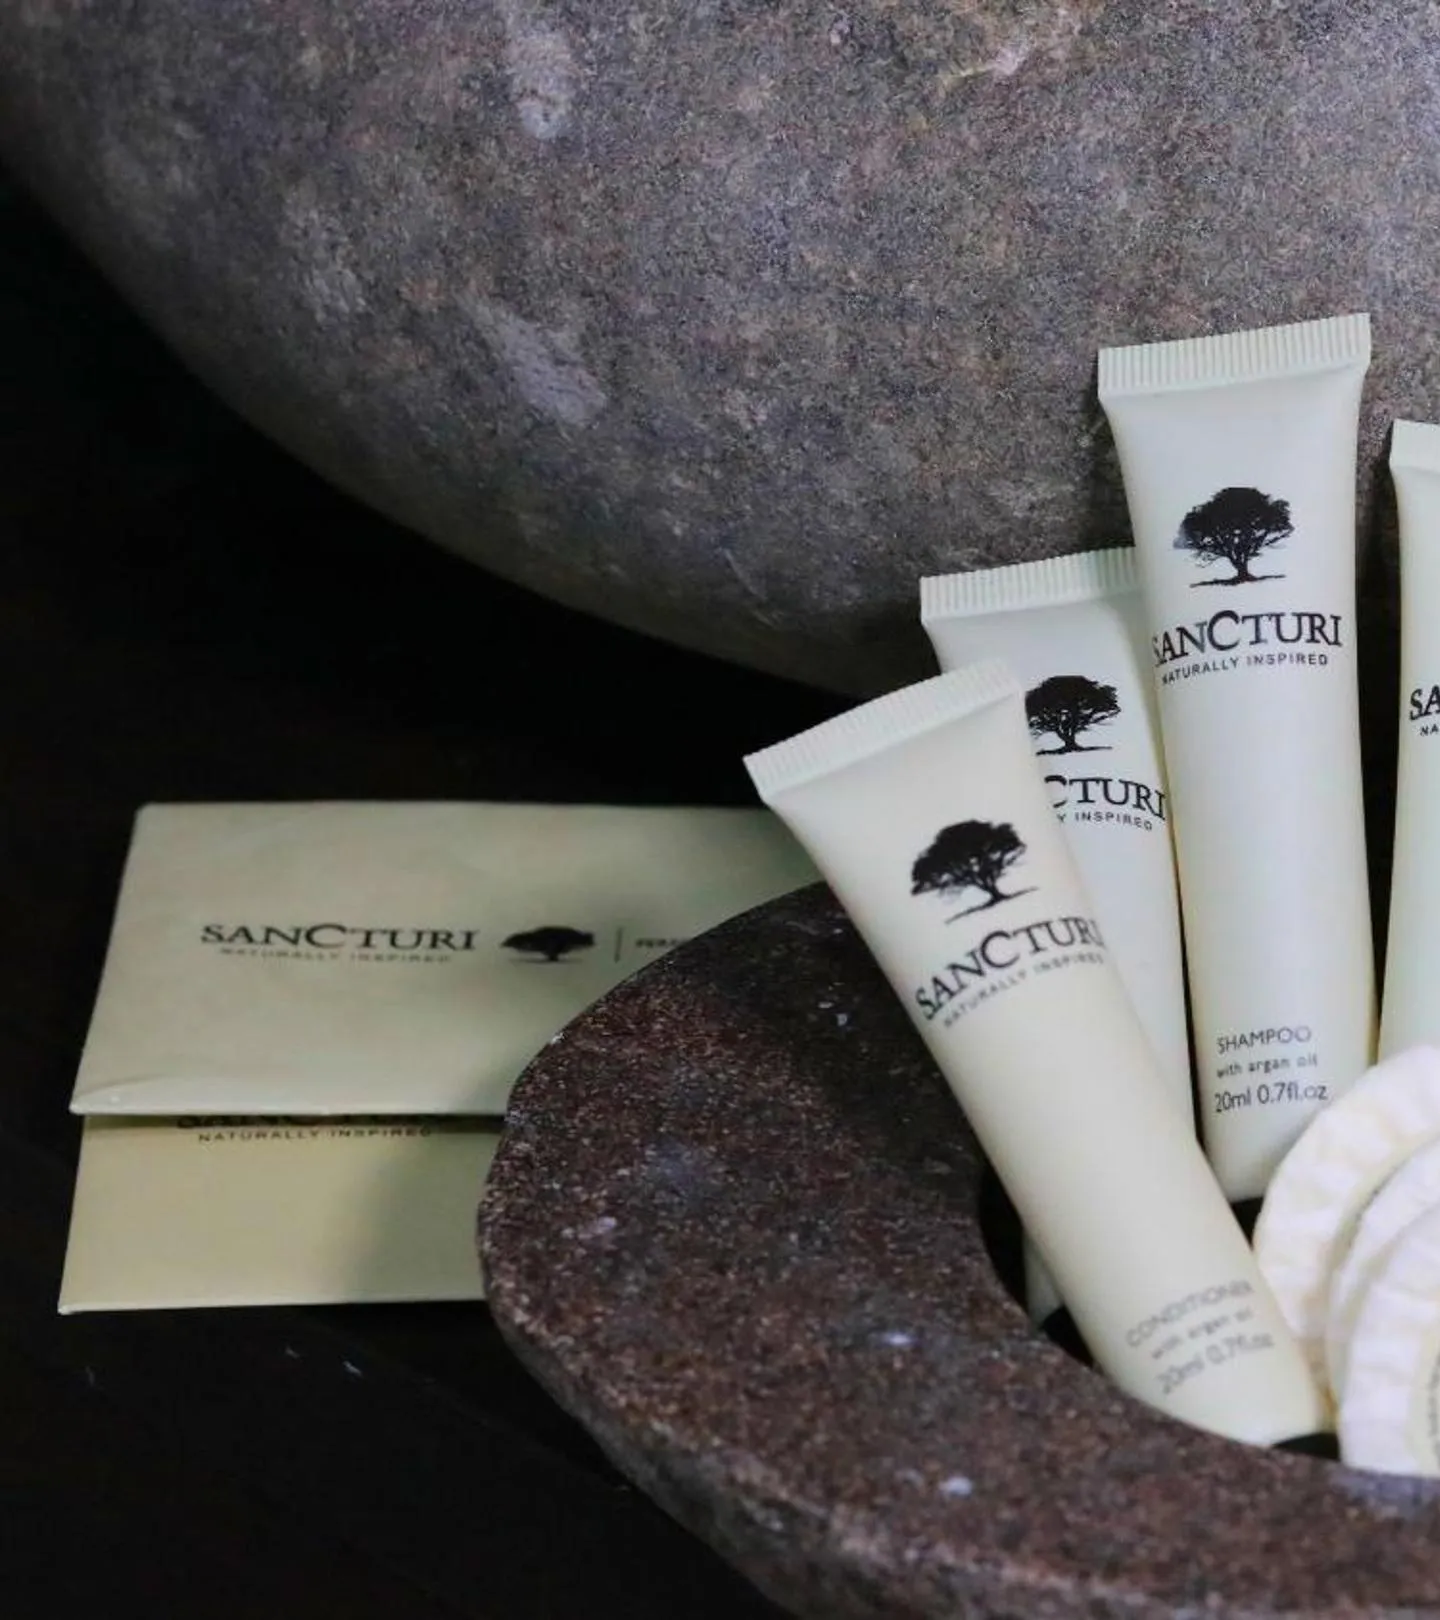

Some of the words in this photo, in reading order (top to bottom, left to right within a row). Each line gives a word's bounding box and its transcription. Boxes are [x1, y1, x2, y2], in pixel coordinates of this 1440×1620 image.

[1153, 610, 1343, 667] SANCTURI
[1161, 657, 1239, 686] NATURALLY
[1247, 651, 1329, 667] INSPIRED
[1044, 774, 1166, 820] CTURI
[1075, 811, 1153, 831] INSPIRED
[200, 923, 480, 950] SANCTURI
[943, 968, 1028, 1027] NATURALLY
[1216, 1026, 1312, 1054] SHAMPOO
[1216, 1062, 1242, 1078] with
[1248, 1059, 1291, 1074] argan
[1297, 1053, 1317, 1068] oil
[1214, 1086, 1252, 1113] 20ml
[198, 1127, 320, 1142] NATURALLY
[330, 1125, 432, 1138] INSPIRED
